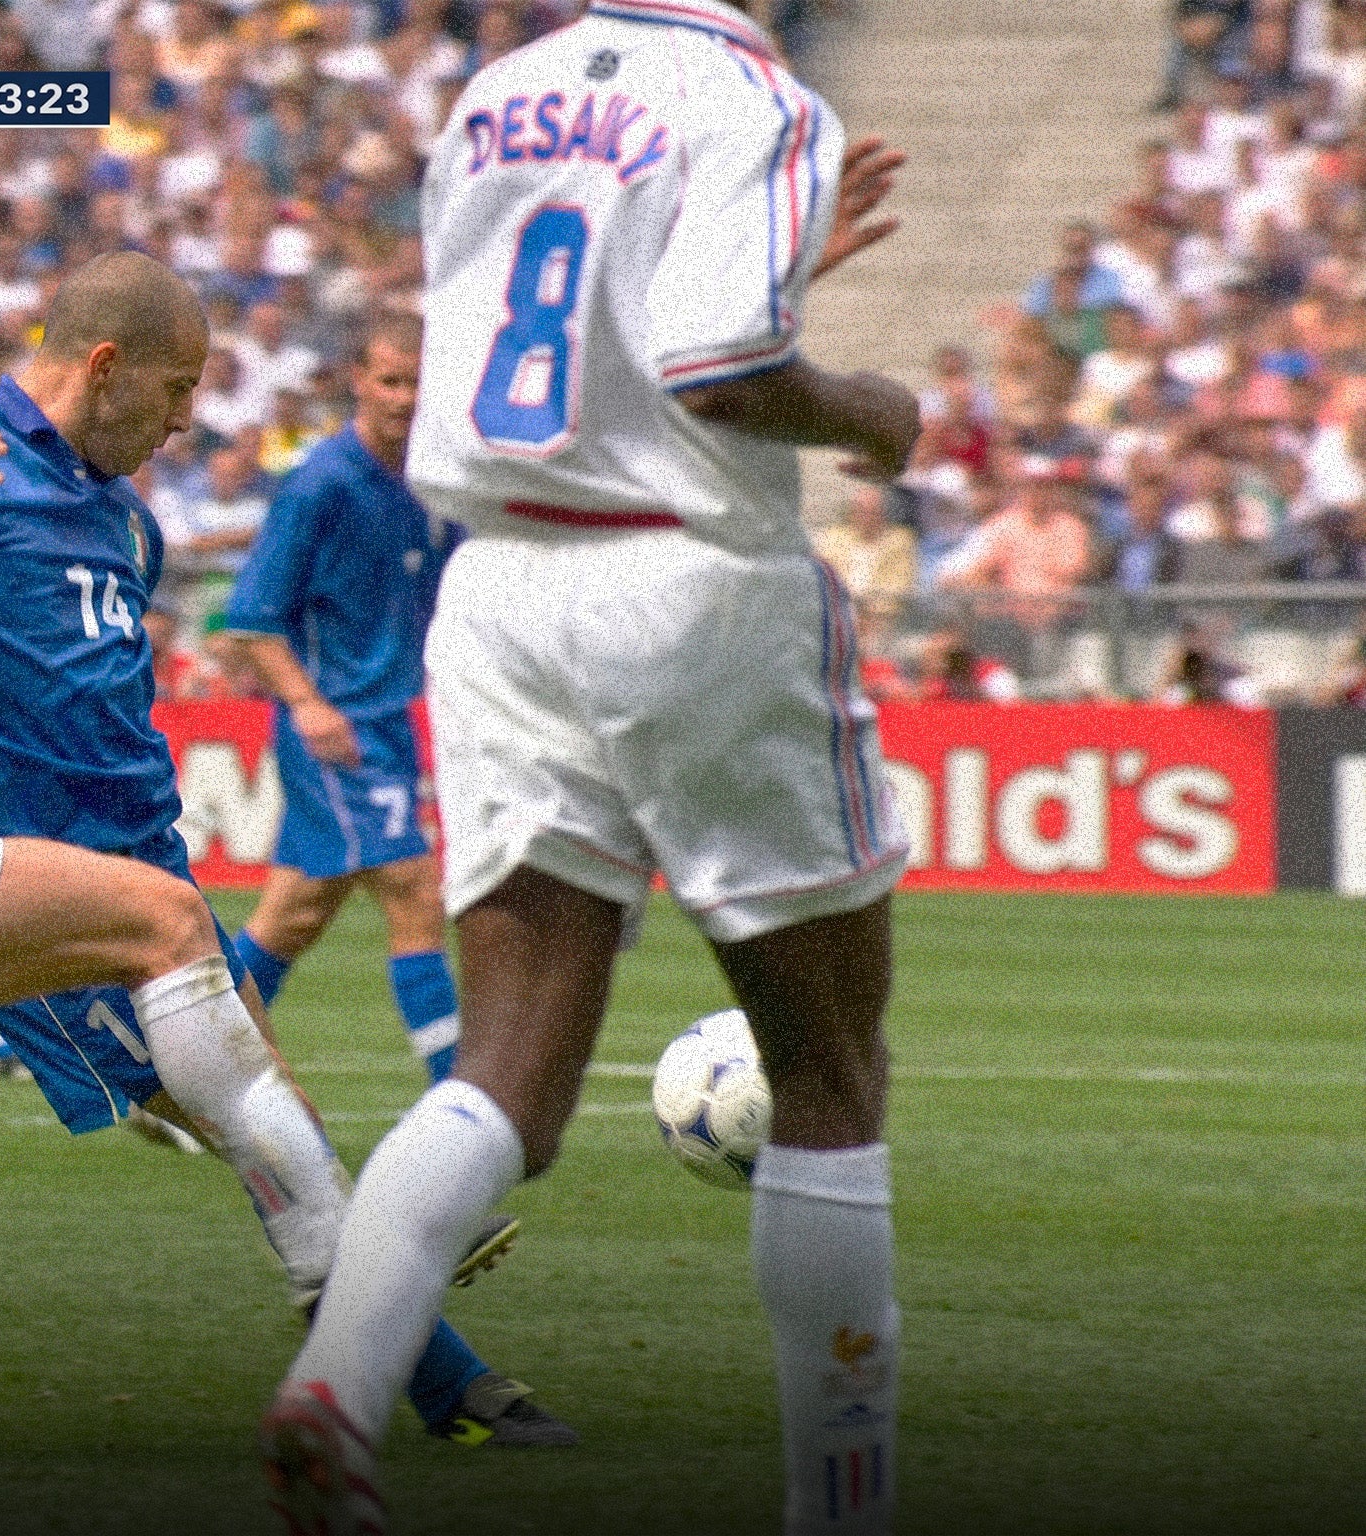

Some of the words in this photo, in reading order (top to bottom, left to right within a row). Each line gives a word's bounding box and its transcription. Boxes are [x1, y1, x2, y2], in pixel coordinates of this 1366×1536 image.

[470, 203, 589, 457] 8
[66, 564, 135, 641] 14
[369, 784, 409, 839] 7
[86, 998, 152, 1066] 1
